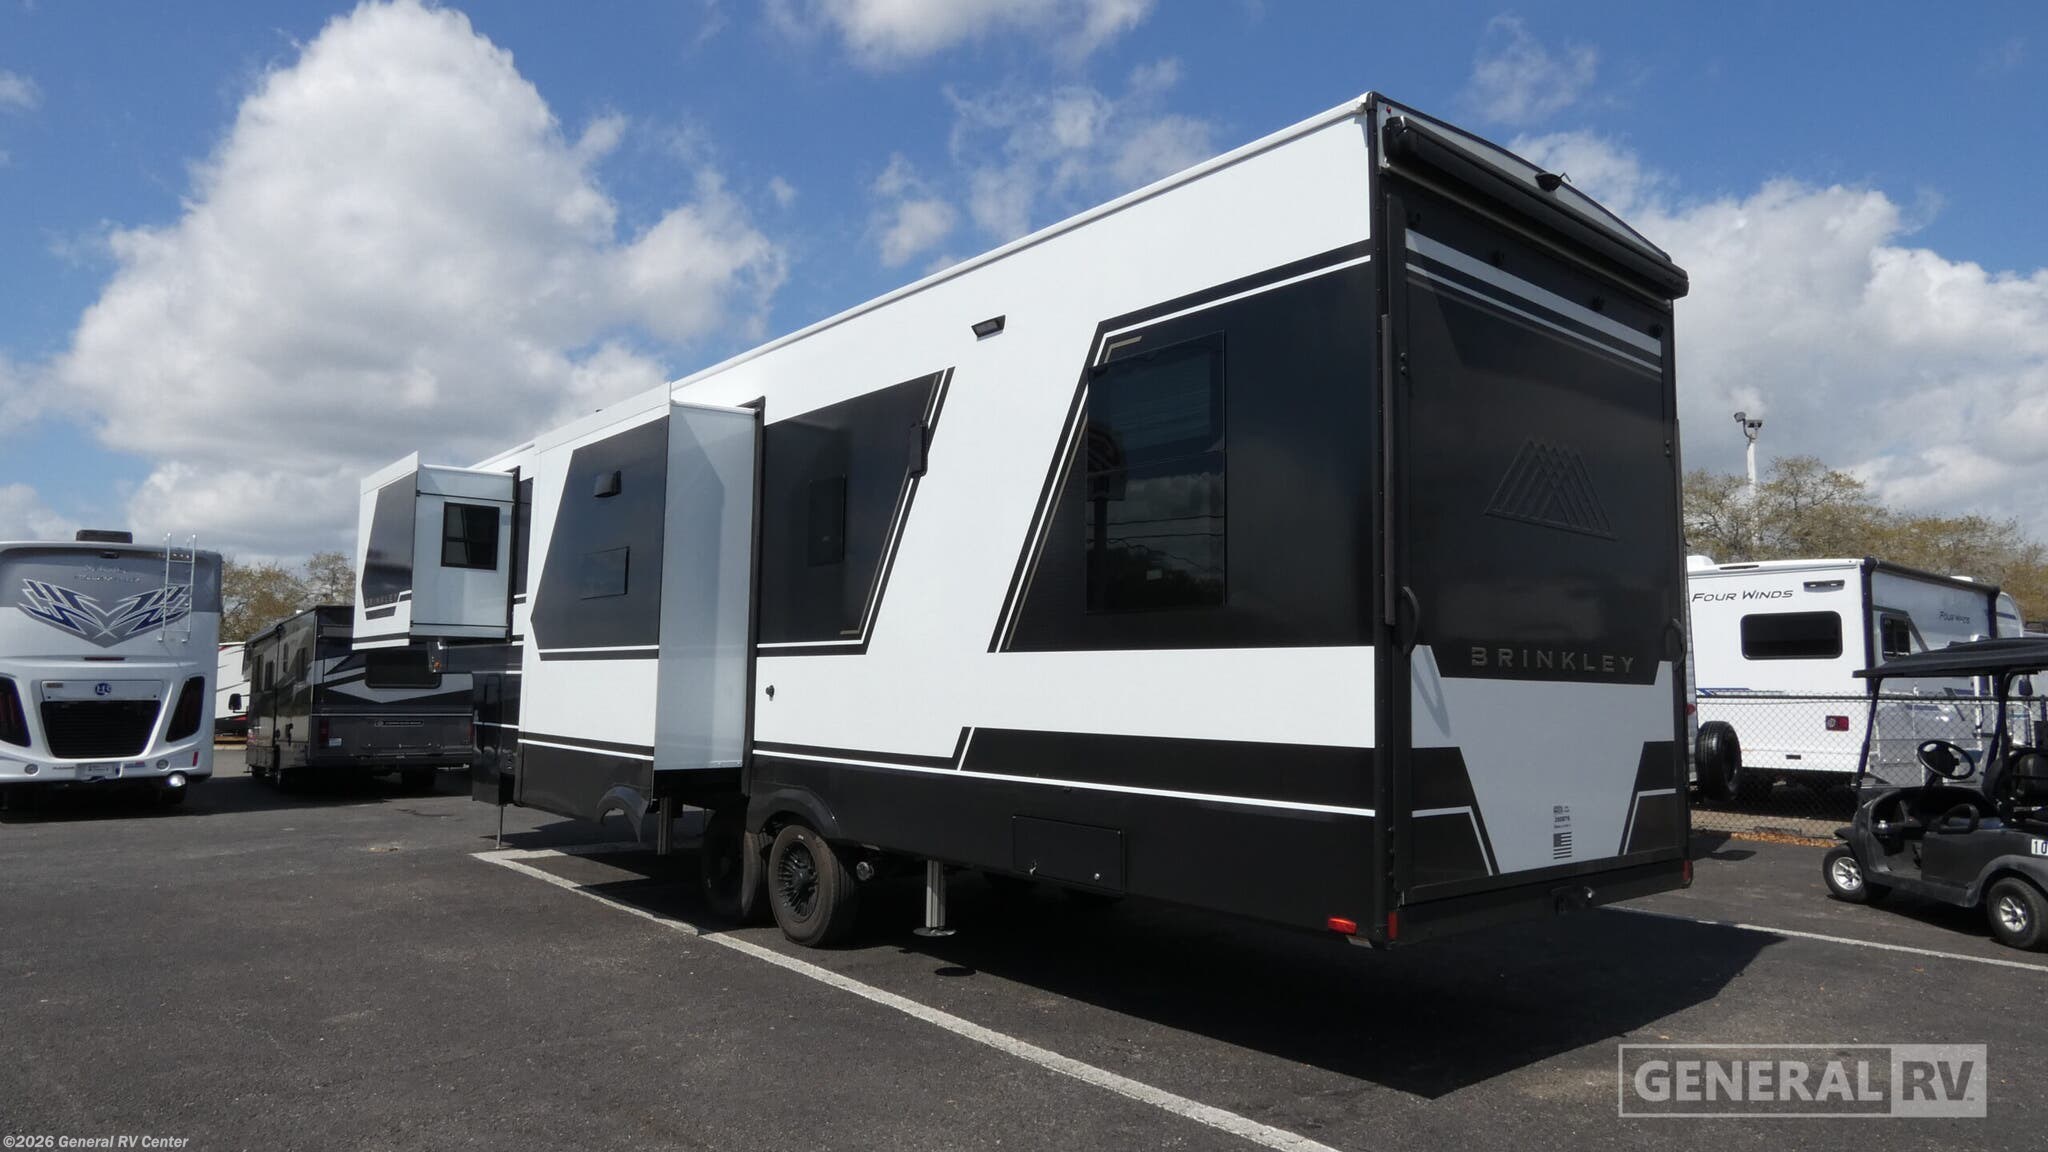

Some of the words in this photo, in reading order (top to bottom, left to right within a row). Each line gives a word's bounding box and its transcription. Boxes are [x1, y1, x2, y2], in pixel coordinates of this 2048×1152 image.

[1692, 593, 1736, 602] FOUR
[1742, 590, 1793, 599] WINDS
[1471, 646, 1634, 673] BRINKLEY
